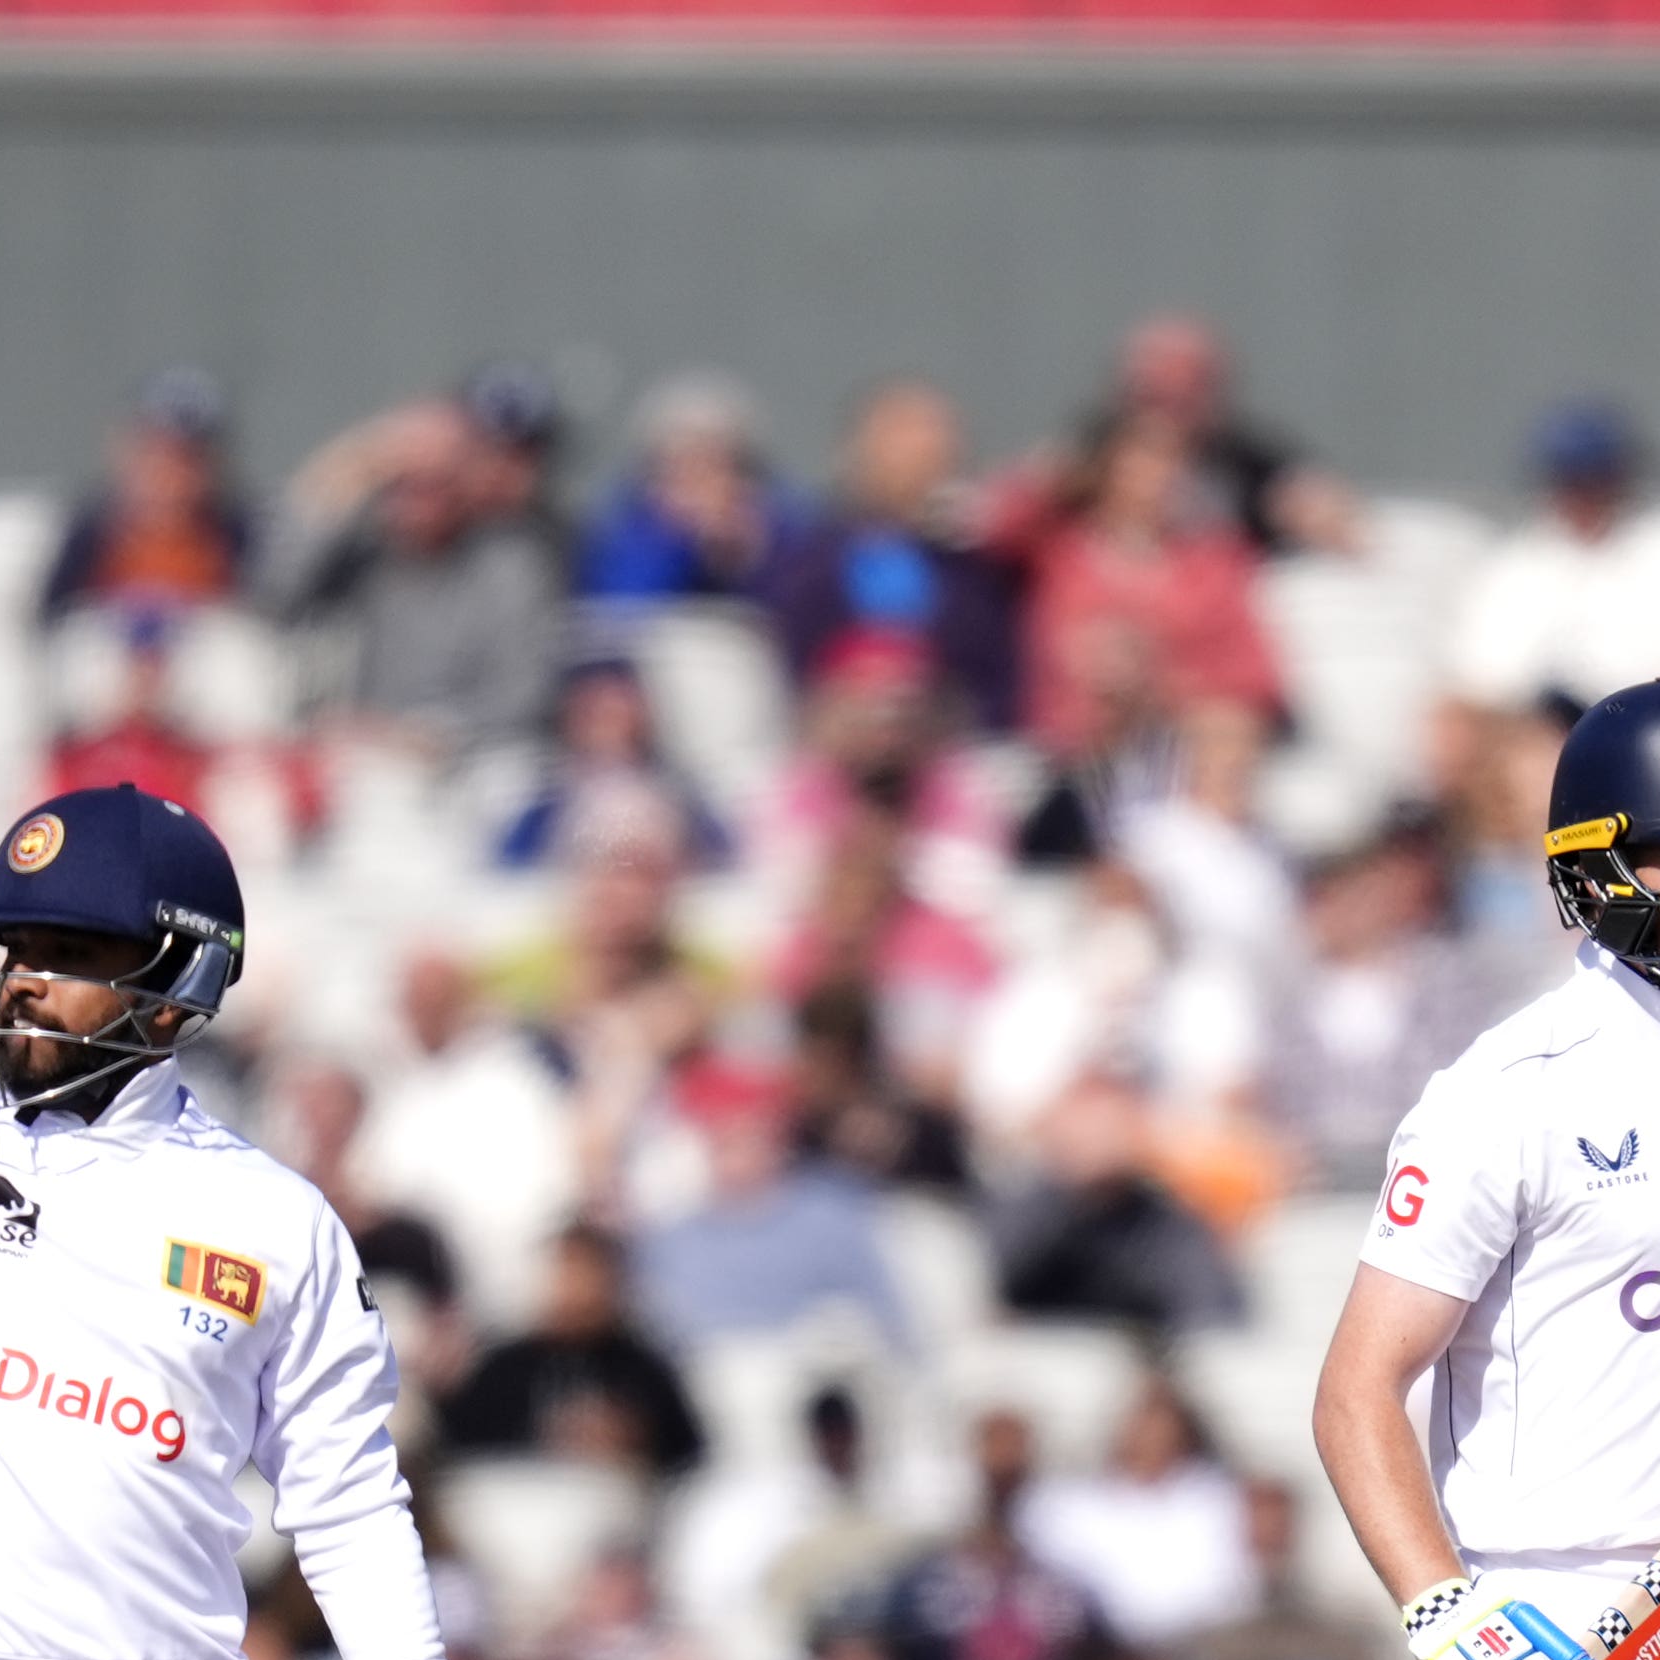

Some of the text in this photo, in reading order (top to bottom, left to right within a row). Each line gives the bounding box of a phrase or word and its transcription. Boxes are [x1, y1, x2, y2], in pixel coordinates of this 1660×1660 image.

[175, 908, 218, 935] SHREY
[1587, 1171, 1649, 1191] CASTORE
[179, 1306, 229, 1342] 132
